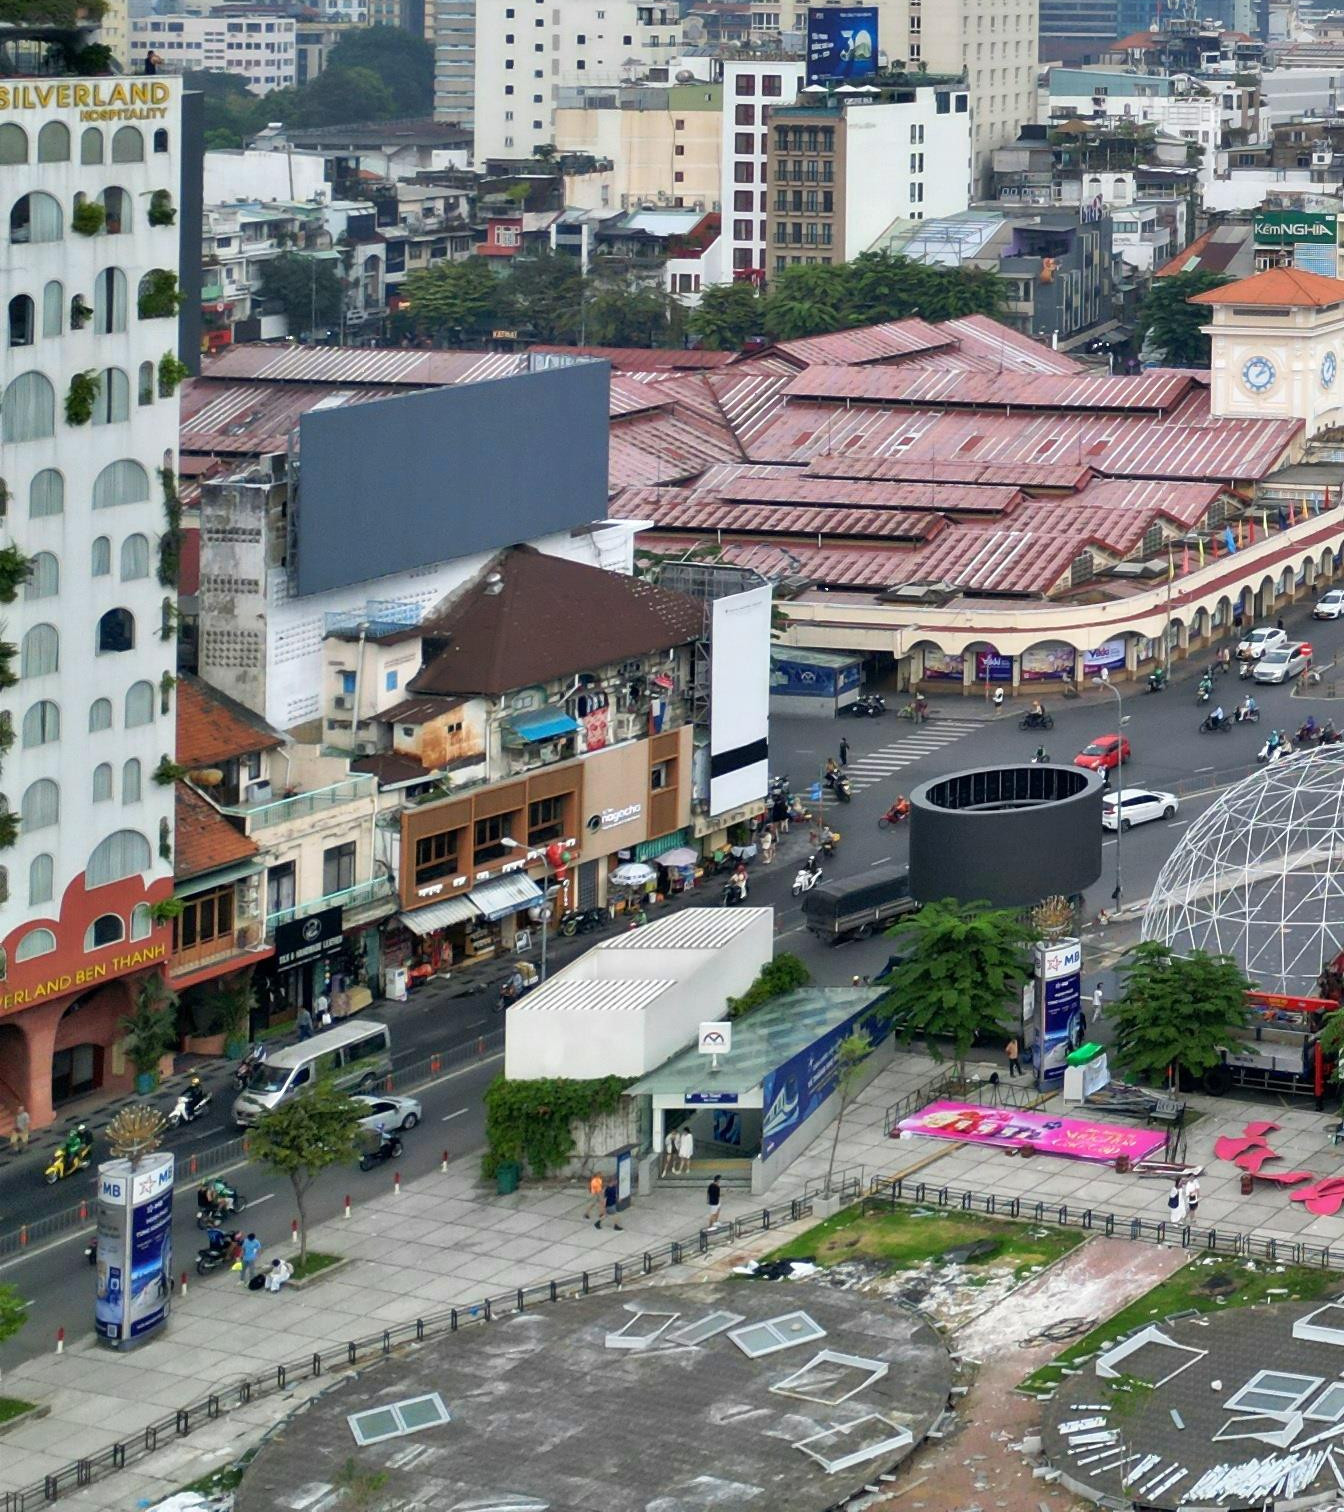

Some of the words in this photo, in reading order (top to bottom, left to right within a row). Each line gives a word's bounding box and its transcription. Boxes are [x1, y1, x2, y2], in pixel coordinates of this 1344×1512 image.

[0, 82, 170, 110] SILVERLAND
[80, 107, 168, 123] HOSPITALITY
[75, 962, 107, 986] BEN
[112, 943, 165, 973] THANH
[1064, 951, 1080, 966] MB
[103, 1181, 121, 1198] MB
